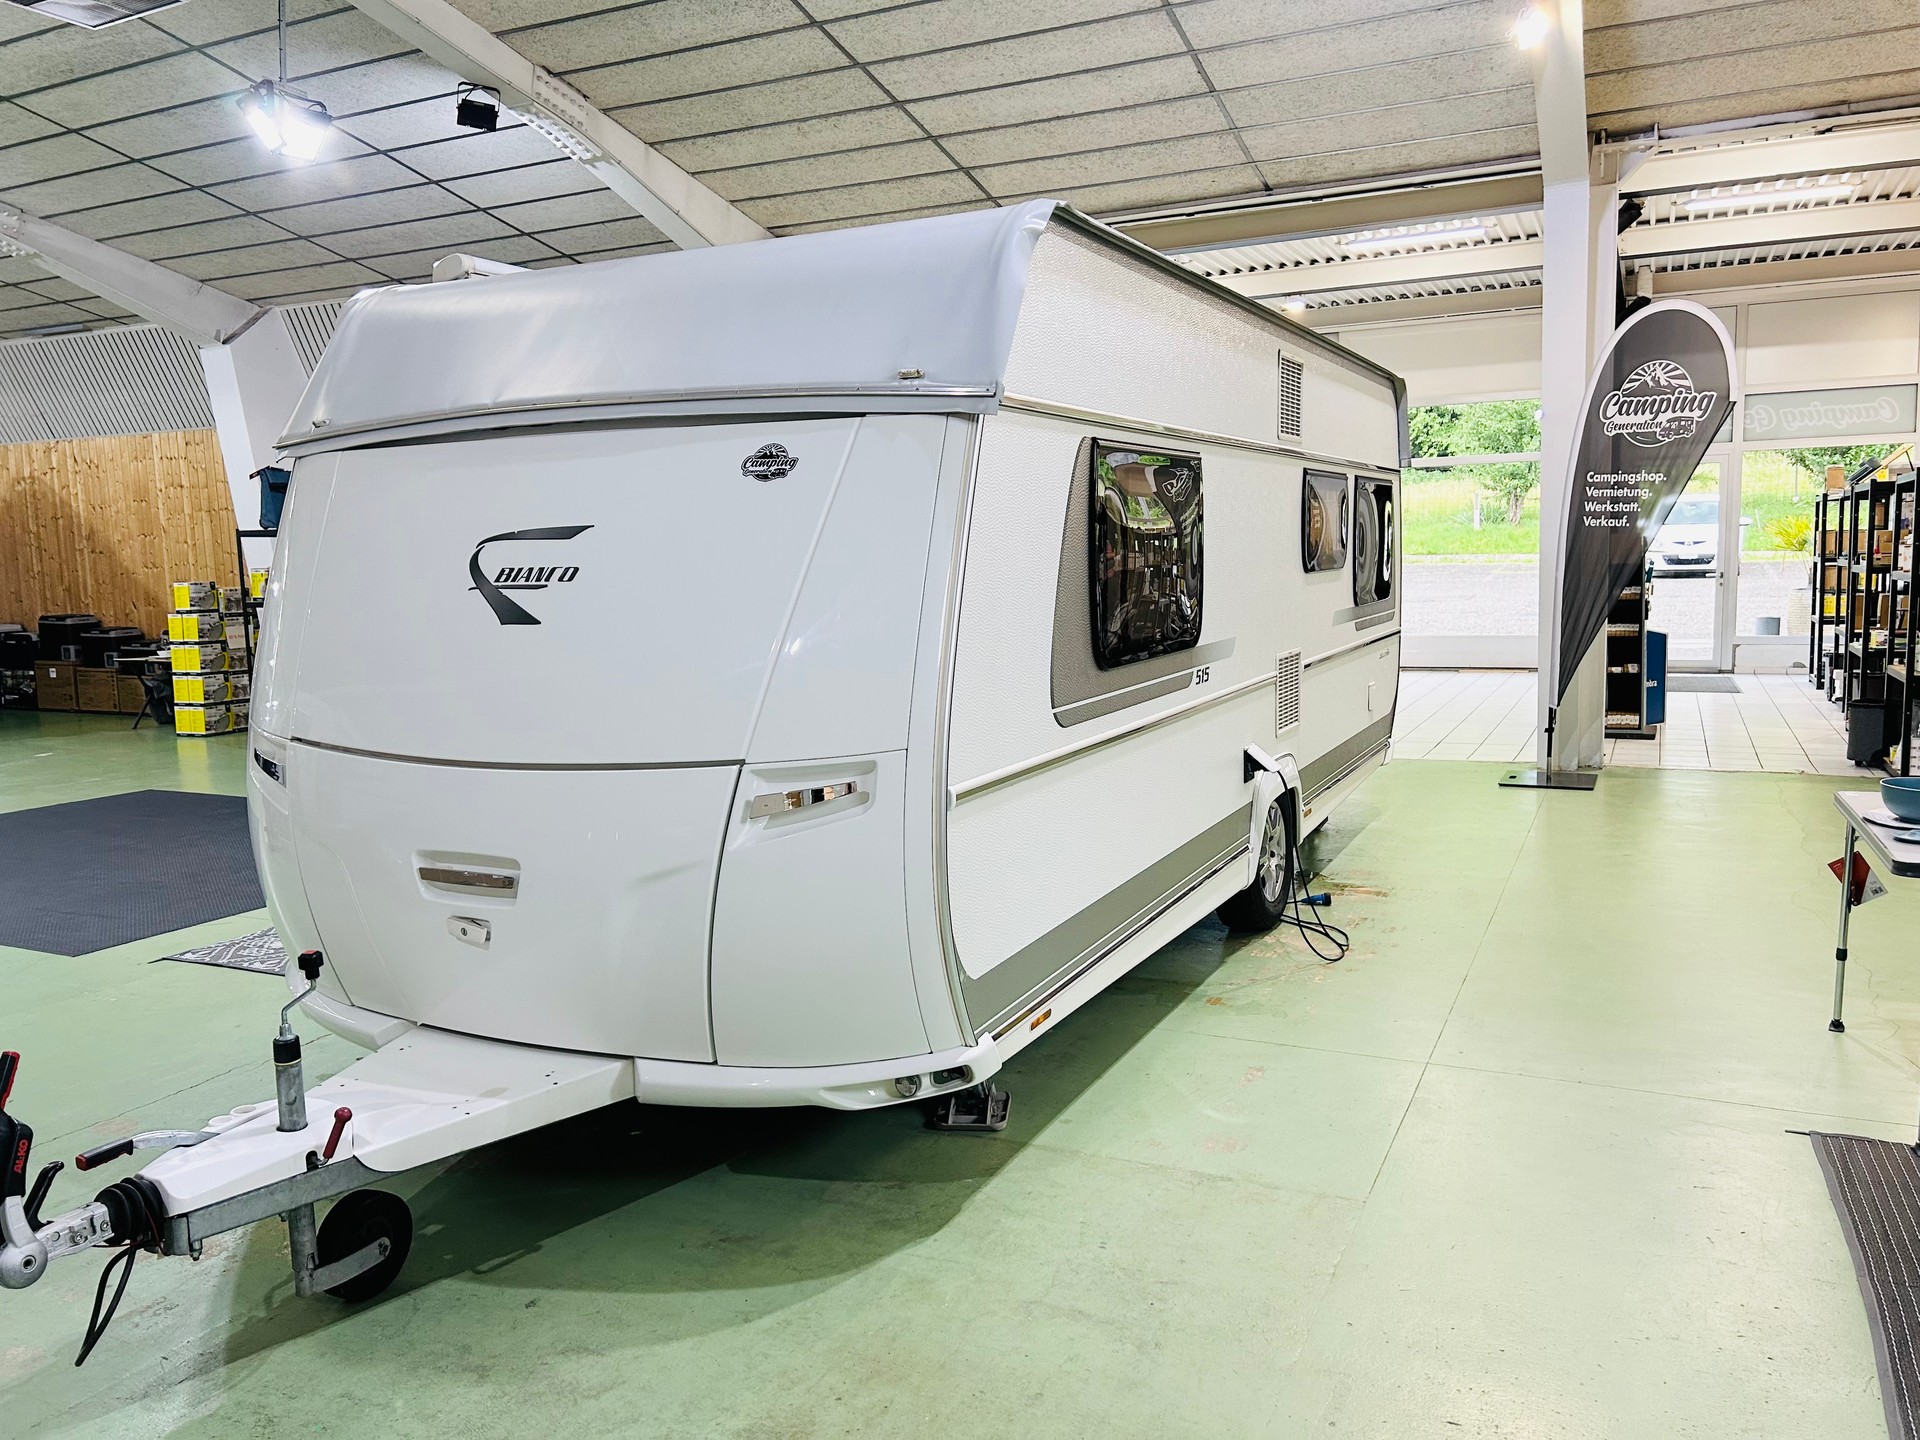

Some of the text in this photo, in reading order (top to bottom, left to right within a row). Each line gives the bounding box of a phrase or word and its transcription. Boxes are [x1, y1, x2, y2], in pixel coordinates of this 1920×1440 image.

[1601, 391, 1716, 421] Camping
[1605, 420, 1662, 434] Generation
[742, 456, 798, 471] Camping
[1586, 469, 1667, 485] Campingshop.
[1585, 486, 1653, 500] Vermietung.
[1584, 500, 1641, 512] Werkstatt.
[1583, 515, 1630, 527] Verkauf.
[493, 566, 580, 583] BIANCO
[1195, 666, 1210, 685] 515
[13, 1139, 29, 1174] AL-KO
